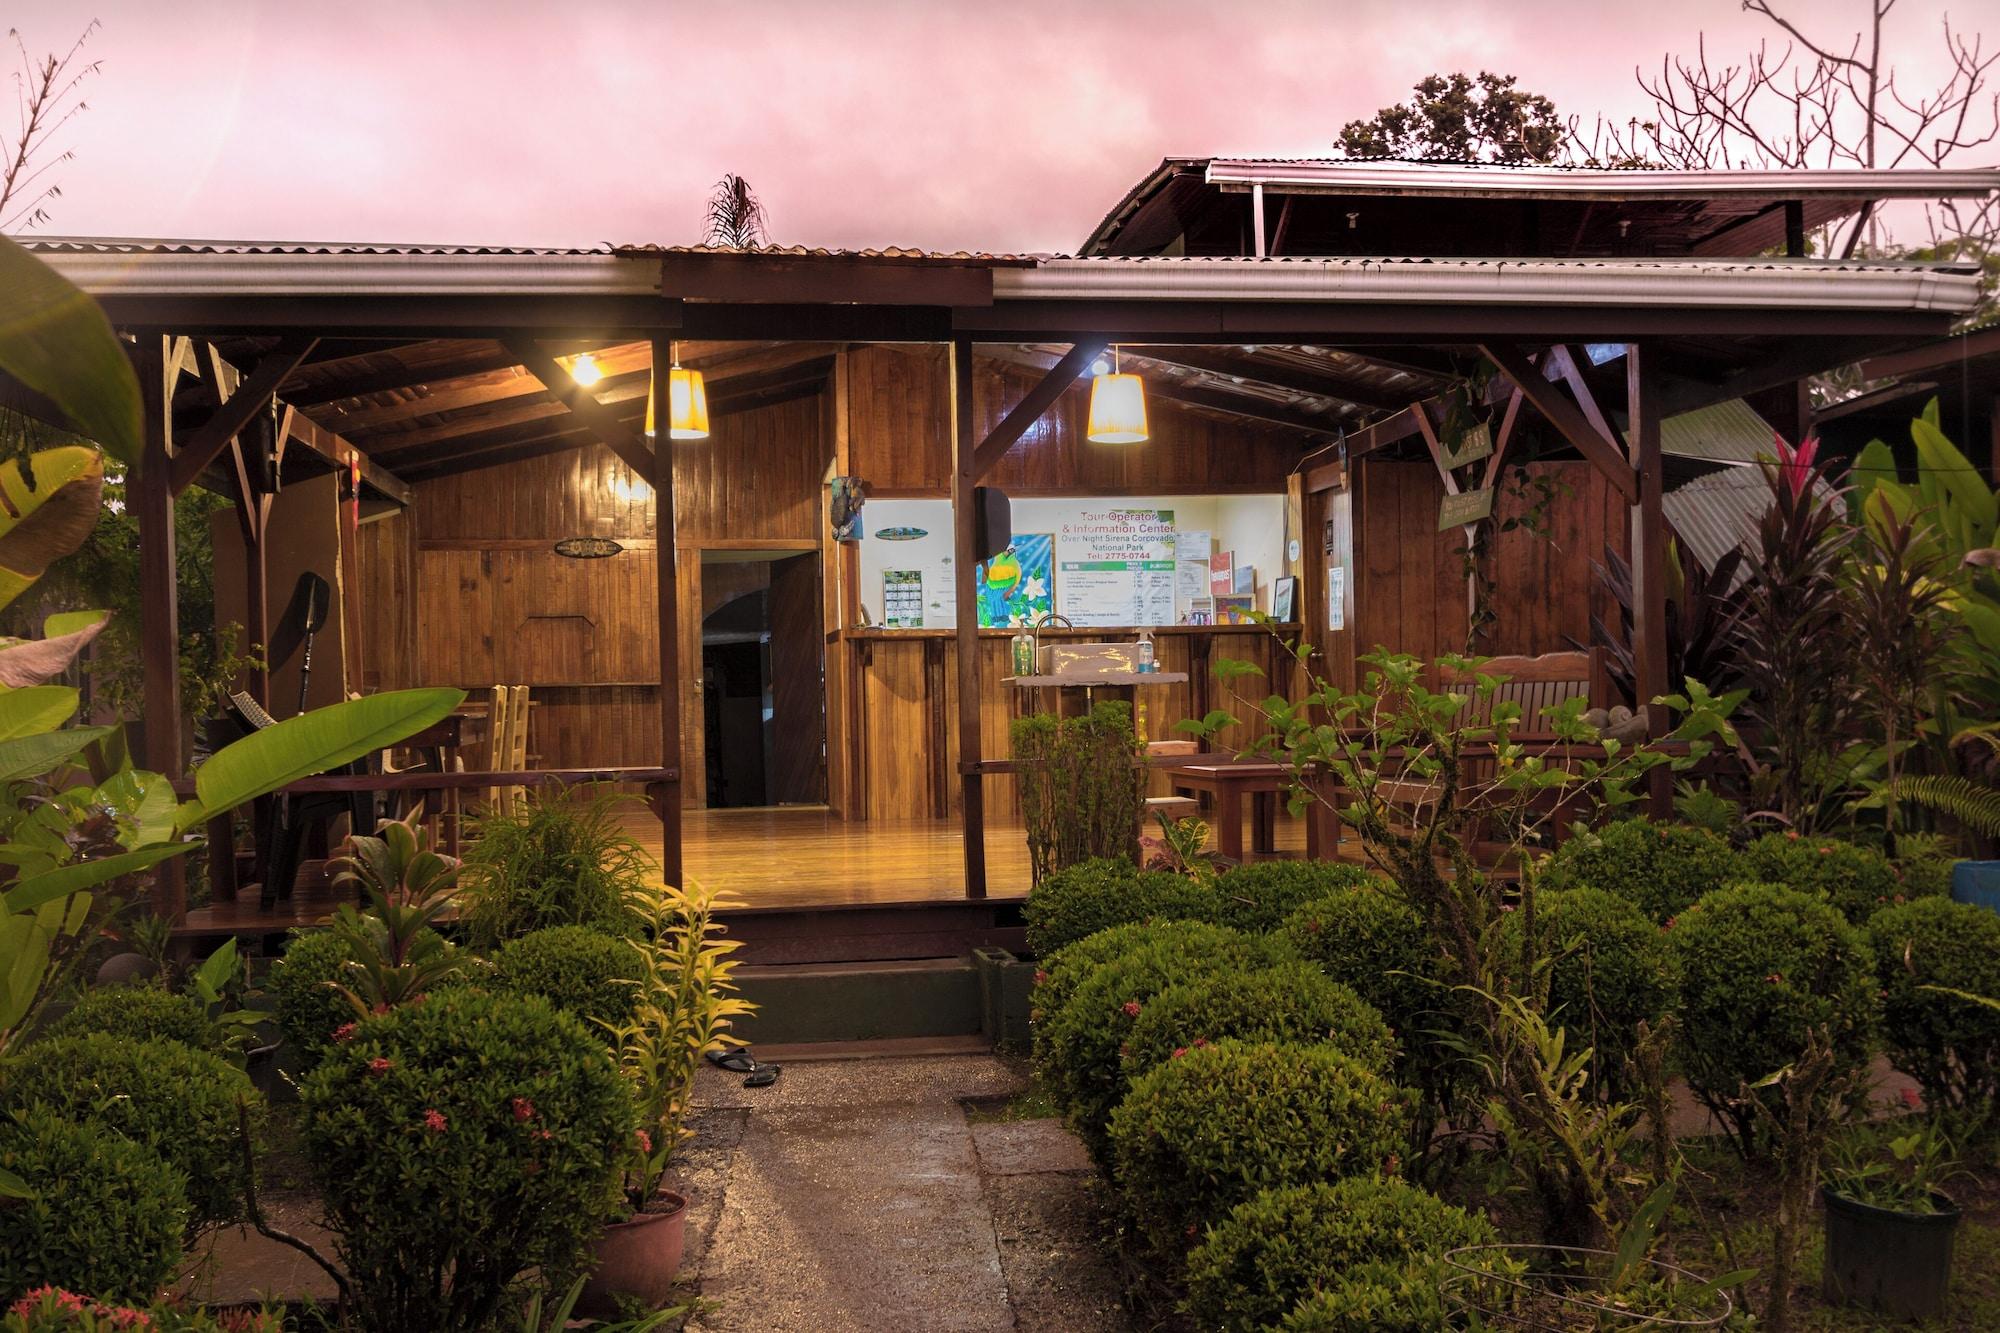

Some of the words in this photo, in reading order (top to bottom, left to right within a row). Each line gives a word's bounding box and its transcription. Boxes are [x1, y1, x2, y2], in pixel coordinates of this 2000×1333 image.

[1081, 512, 1105, 521] Tour
[1108, 512, 1156, 522] Operator
[1062, 524, 1070, 533] &
[1073, 524, 1135, 533] Information
[1139, 524, 1174, 533] Center
[1082, 534, 1103, 543] Night
[1131, 534, 1174, 542] Corcovado
[1092, 543, 1124, 551] National
[1126, 543, 1144, 551] Park
[1087, 552, 1102, 560] Tel:
[1105, 552, 1150, 560] 2775-0744
